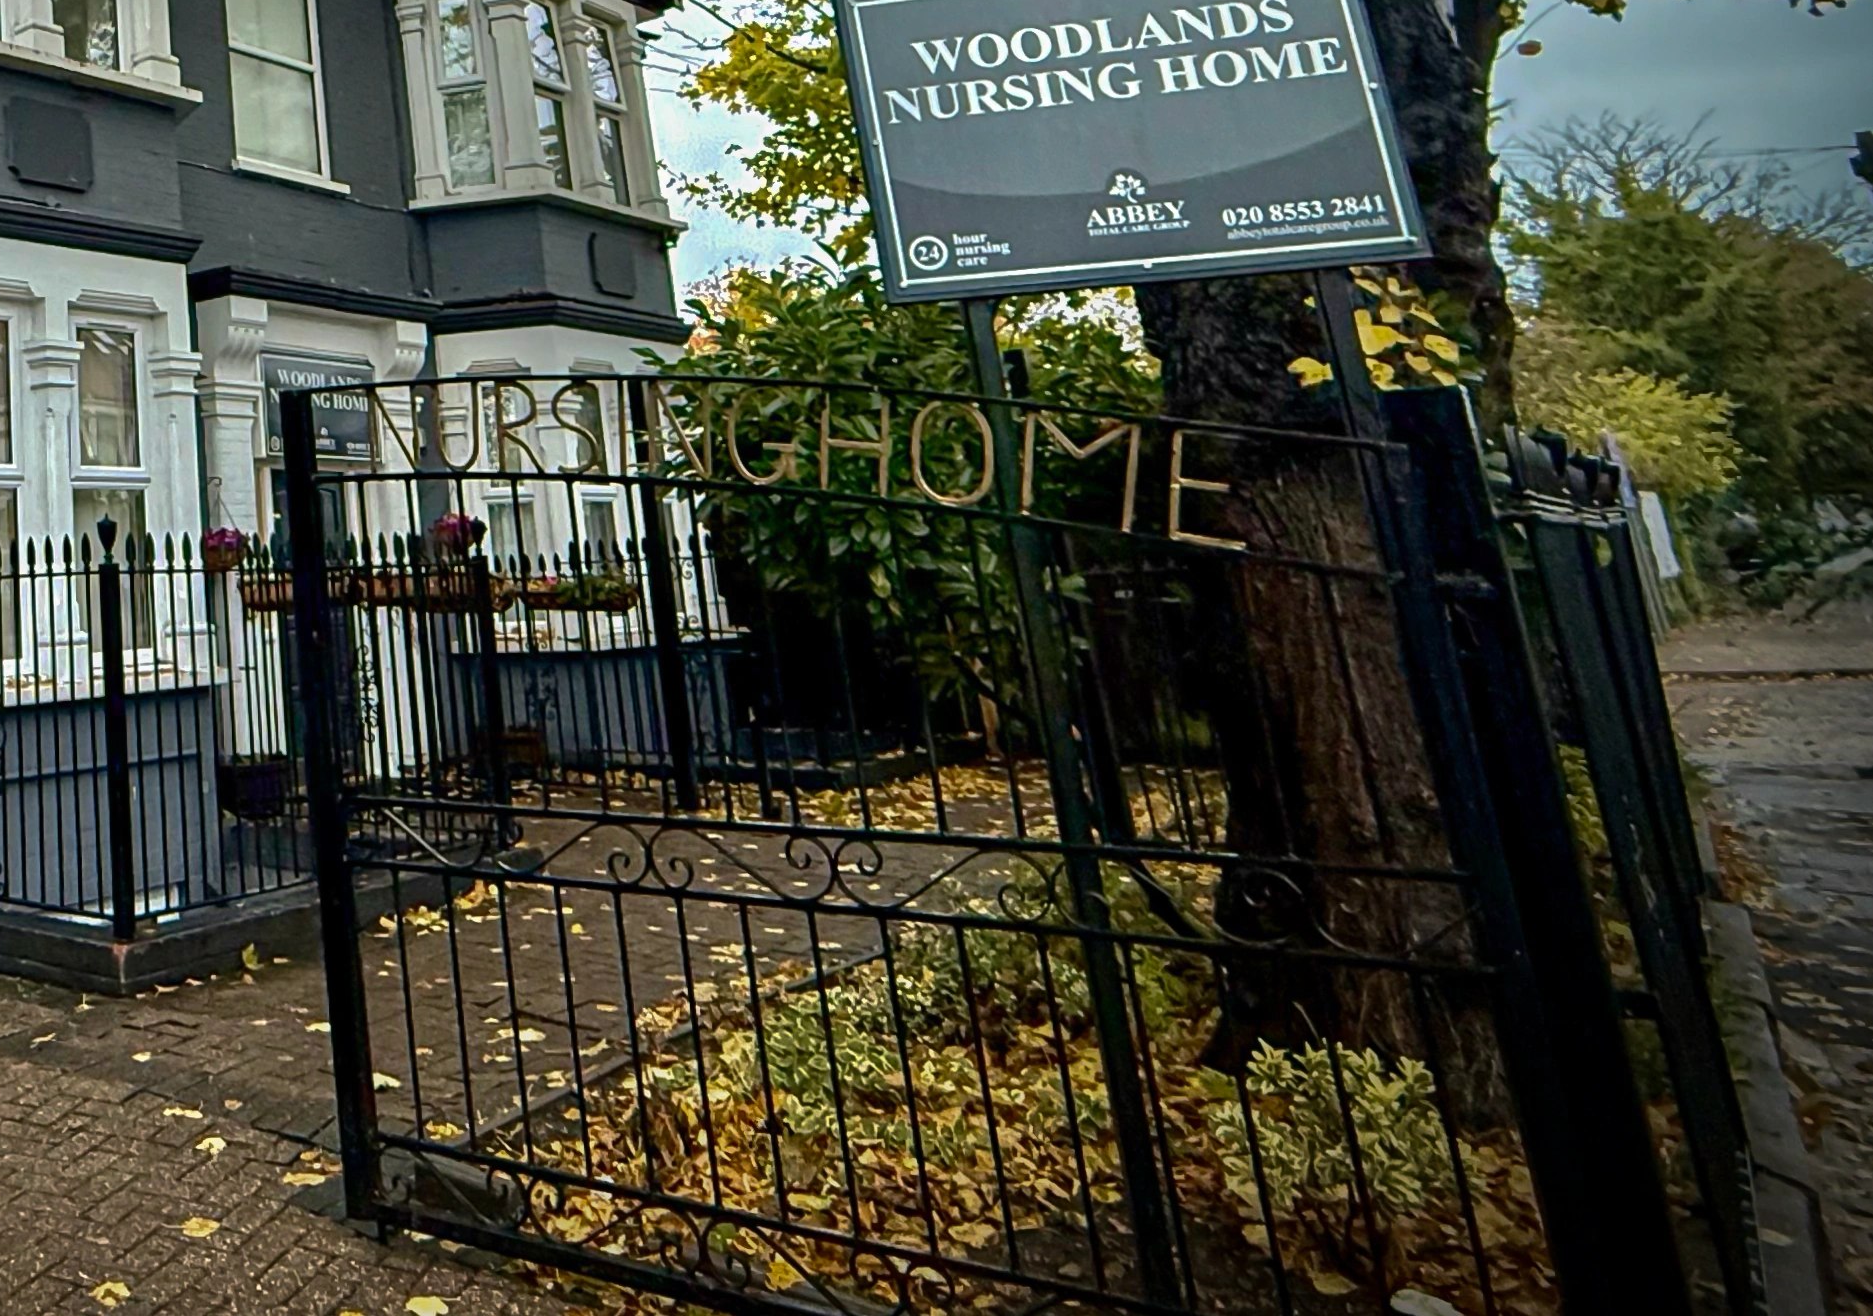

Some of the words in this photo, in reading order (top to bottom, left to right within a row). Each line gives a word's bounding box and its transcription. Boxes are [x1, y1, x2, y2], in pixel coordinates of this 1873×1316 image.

[882, 61, 1142, 124] NURSING
[1154, 37, 1349, 94] HOME
[1087, 200, 1185, 228] ABBEY
[1222, 206, 1264, 227] 020
[1268, 200, 1325, 222] 8553
[1330, 194, 1387, 217] 2841
[952, 233, 988, 245] hour
[917, 245, 940, 262] 24
[955, 241, 1011, 256] nursing
[956, 256, 988, 268] care
